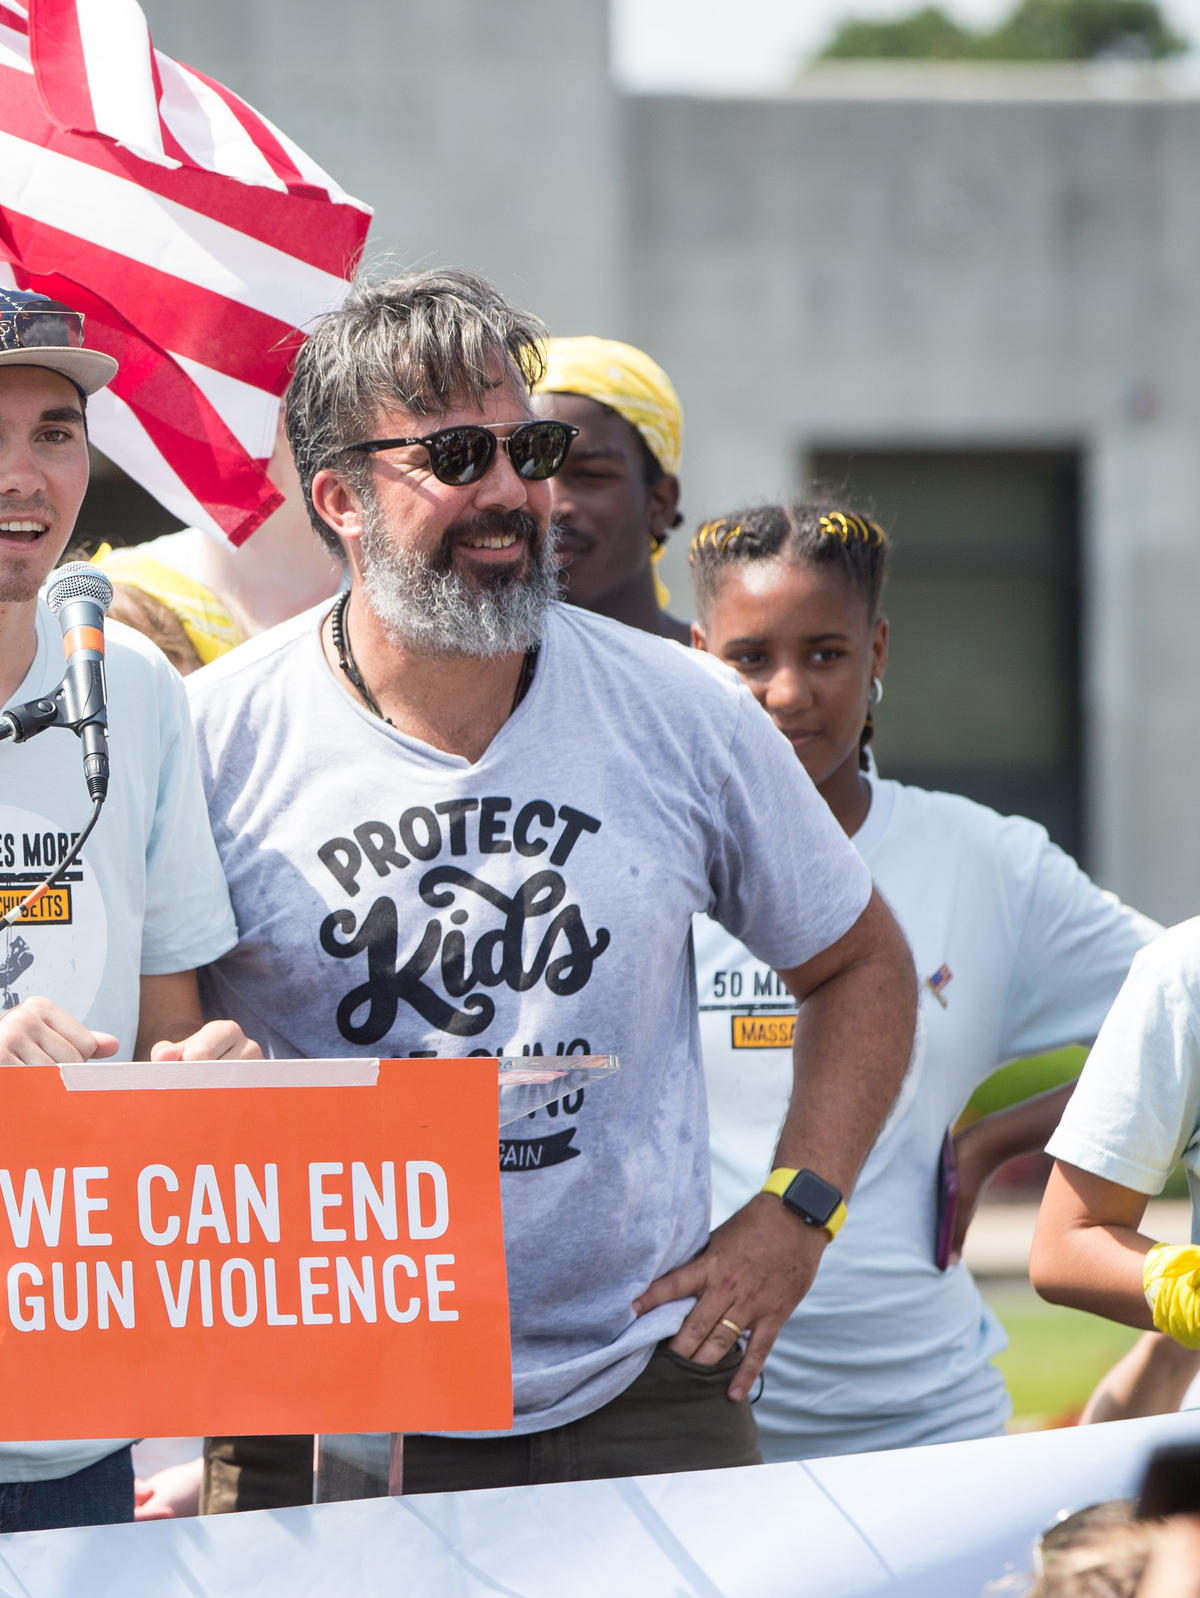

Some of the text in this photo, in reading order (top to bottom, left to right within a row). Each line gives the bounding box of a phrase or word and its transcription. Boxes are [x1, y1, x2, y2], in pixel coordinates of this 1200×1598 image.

[317, 797, 602, 897] PROTECT
[319, 865, 611, 1046] Kids
[714, 971, 742, 998] 50
[137, 1163, 281, 1246] CAN
[308, 1160, 450, 1243] END
[6, 1253, 460, 1332] GUN VIOLENCE
